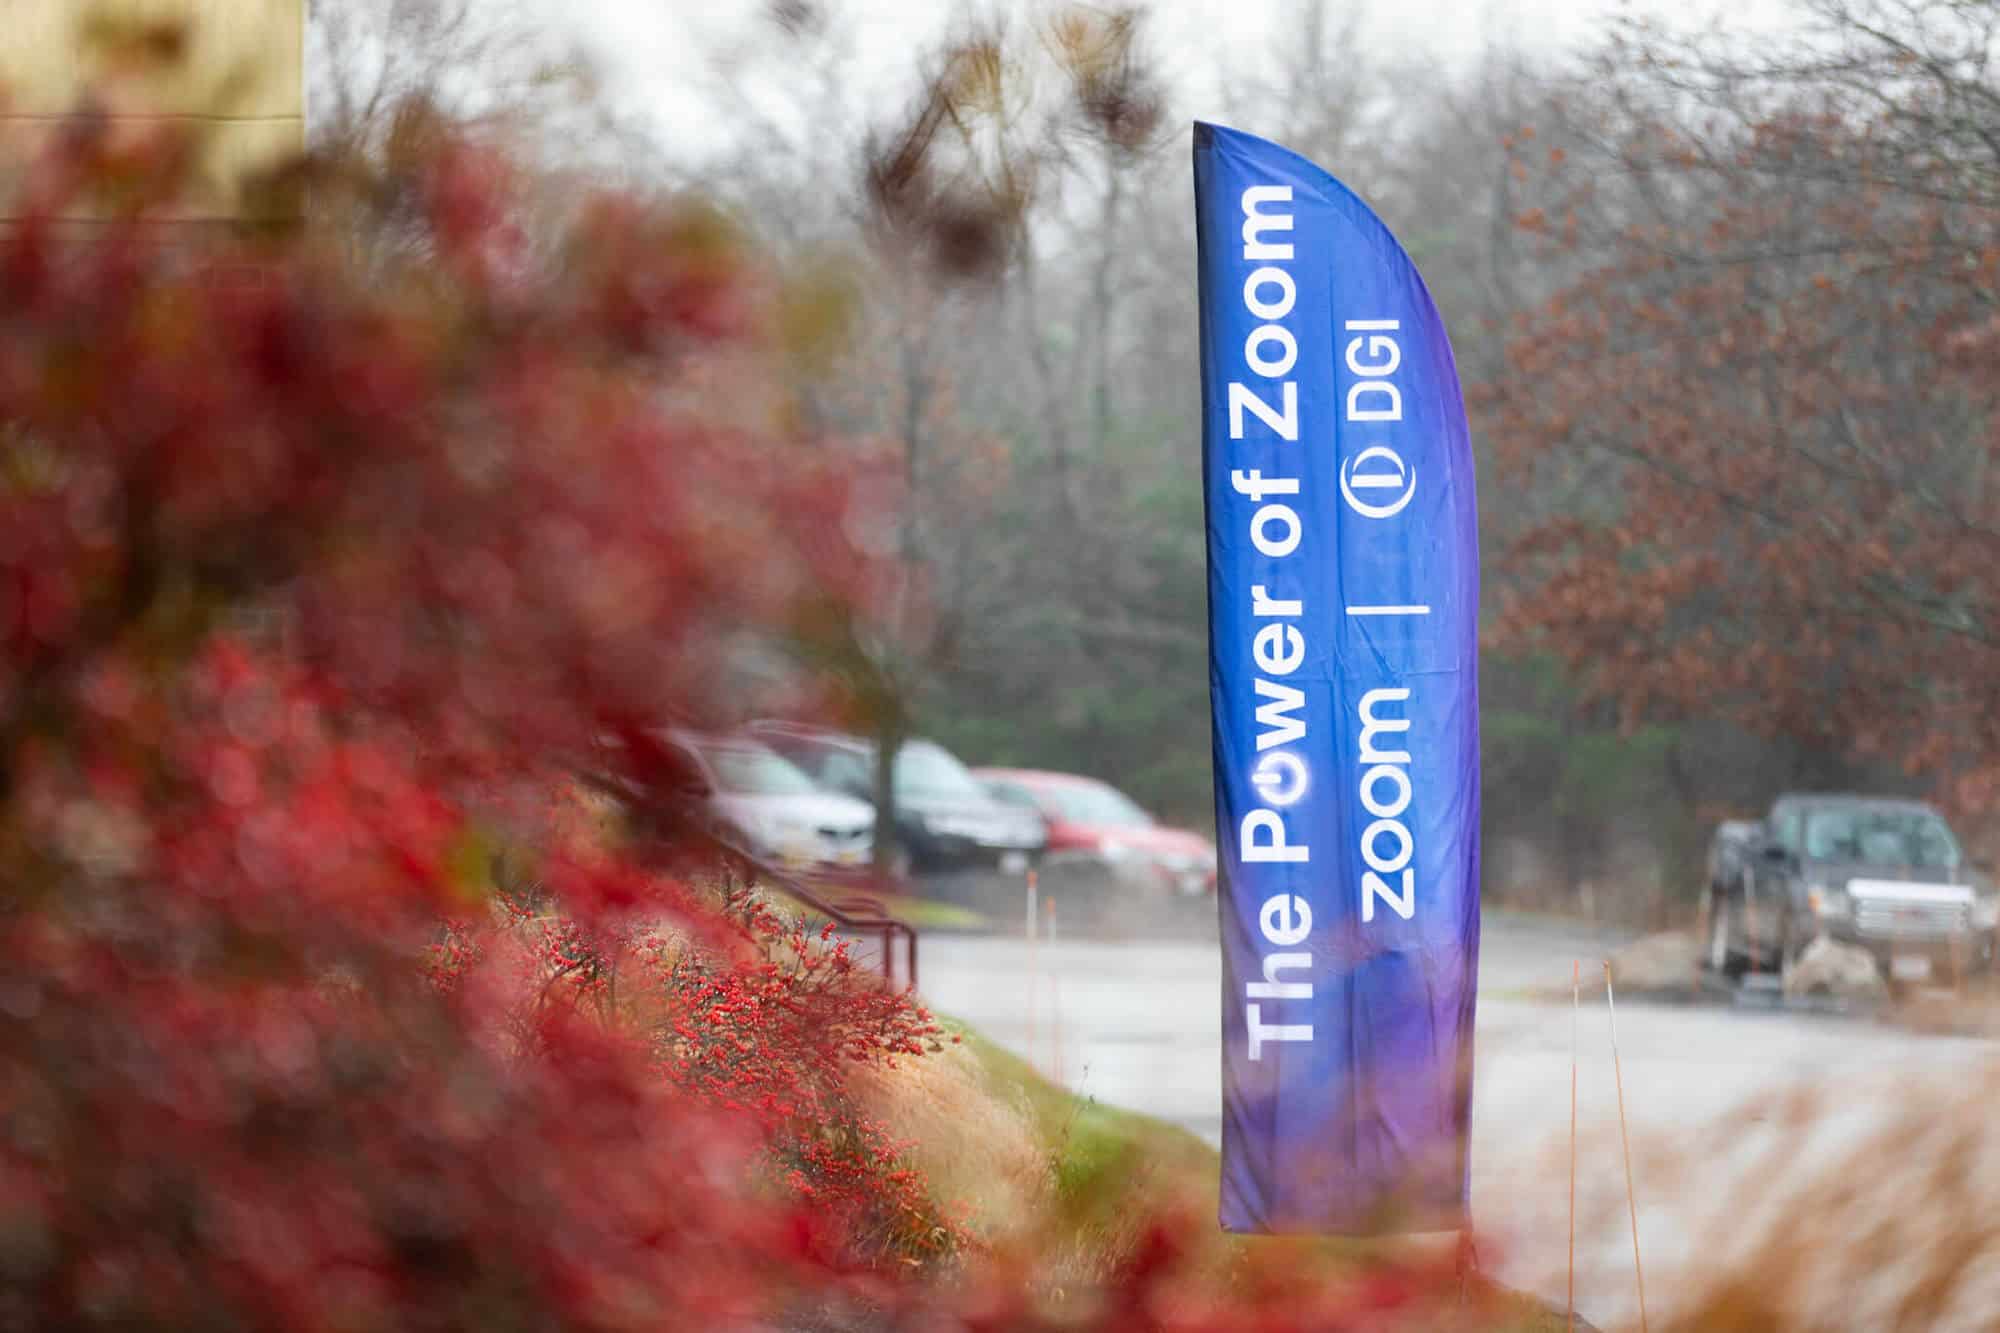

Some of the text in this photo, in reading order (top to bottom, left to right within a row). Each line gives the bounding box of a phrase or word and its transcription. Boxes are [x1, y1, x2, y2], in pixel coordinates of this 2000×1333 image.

[1345, 319, 1402, 421] DGI
[1228, 185, 1314, 1061] The Power of Zoom
[1358, 688, 1415, 922] zoom
